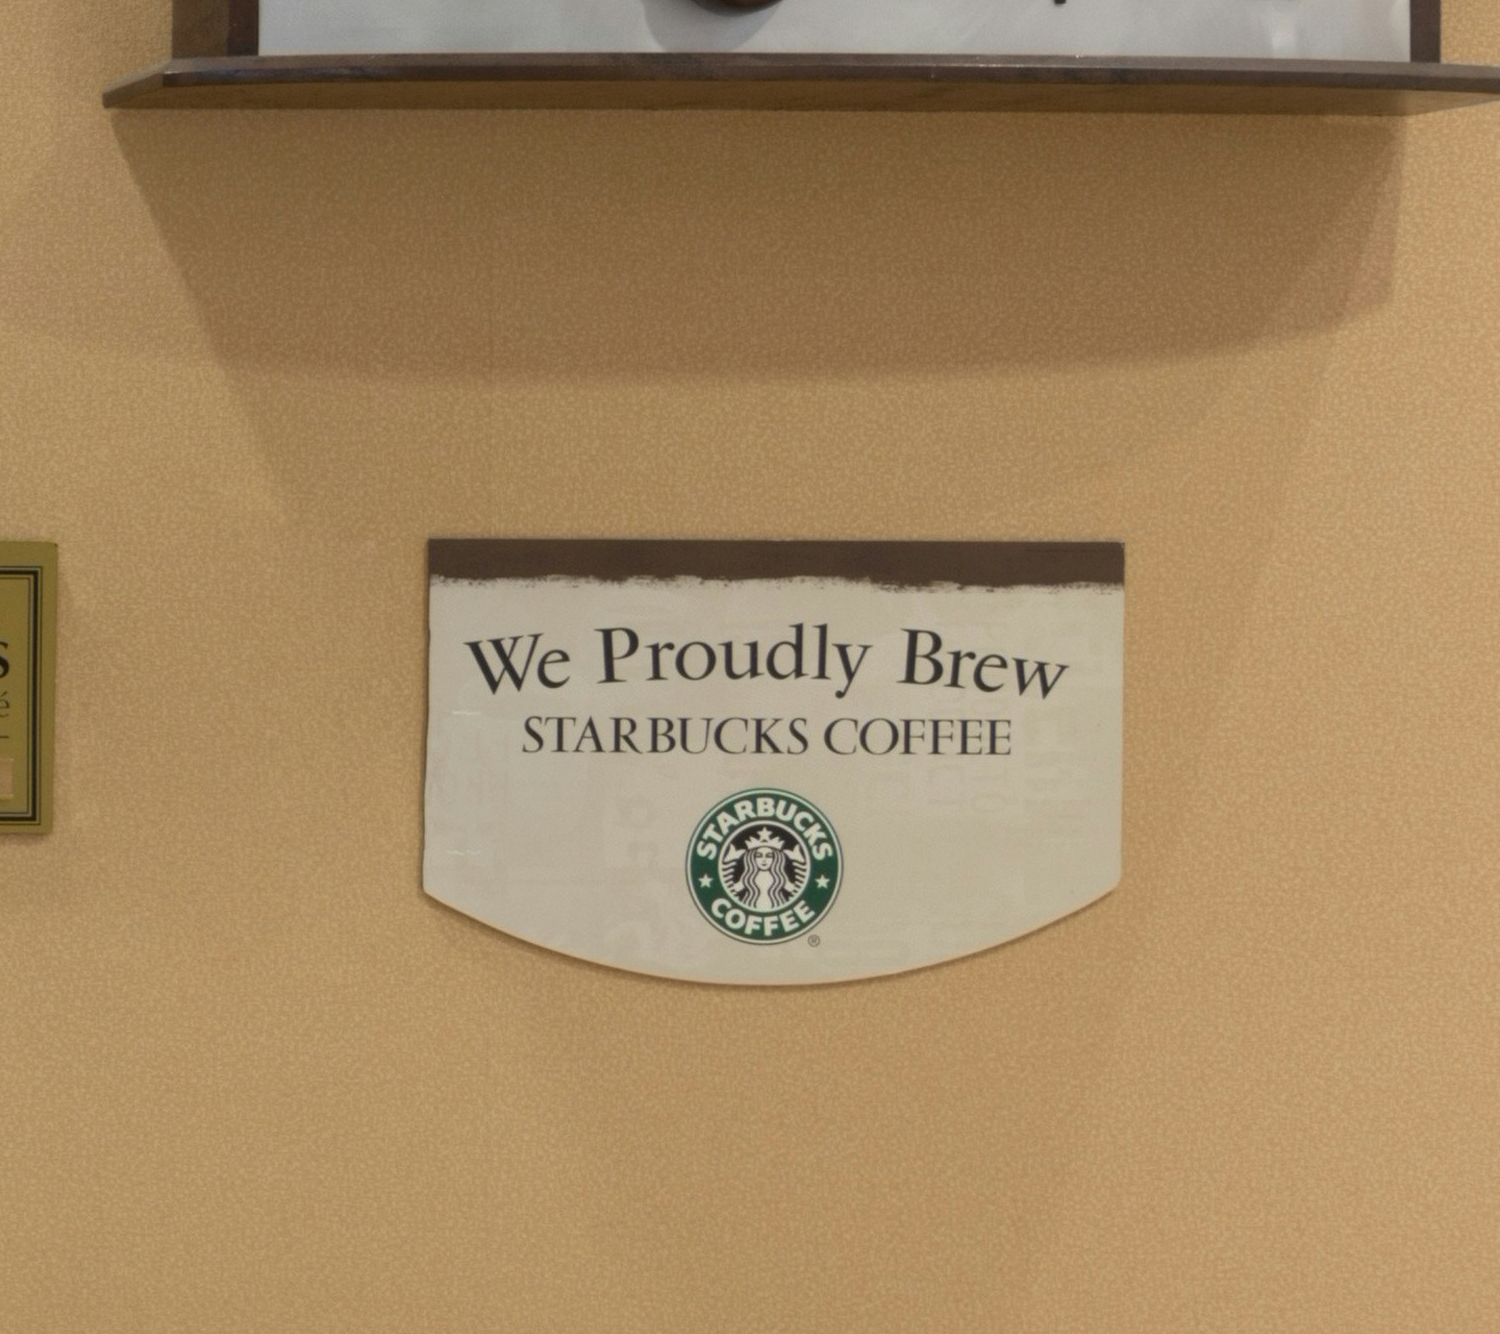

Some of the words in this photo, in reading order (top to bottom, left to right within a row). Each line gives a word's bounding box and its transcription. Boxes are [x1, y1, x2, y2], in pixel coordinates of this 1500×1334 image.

[464, 632, 572, 697] We
[595, 623, 875, 699] Proudly
[900, 626, 1070, 700] Brew
[522, 715, 810, 755] STARBUCKS
[823, 716, 1013, 757] COFFEE
[696, 796, 834, 863] STARBUCKS
[710, 896, 815, 936] COFFEE
